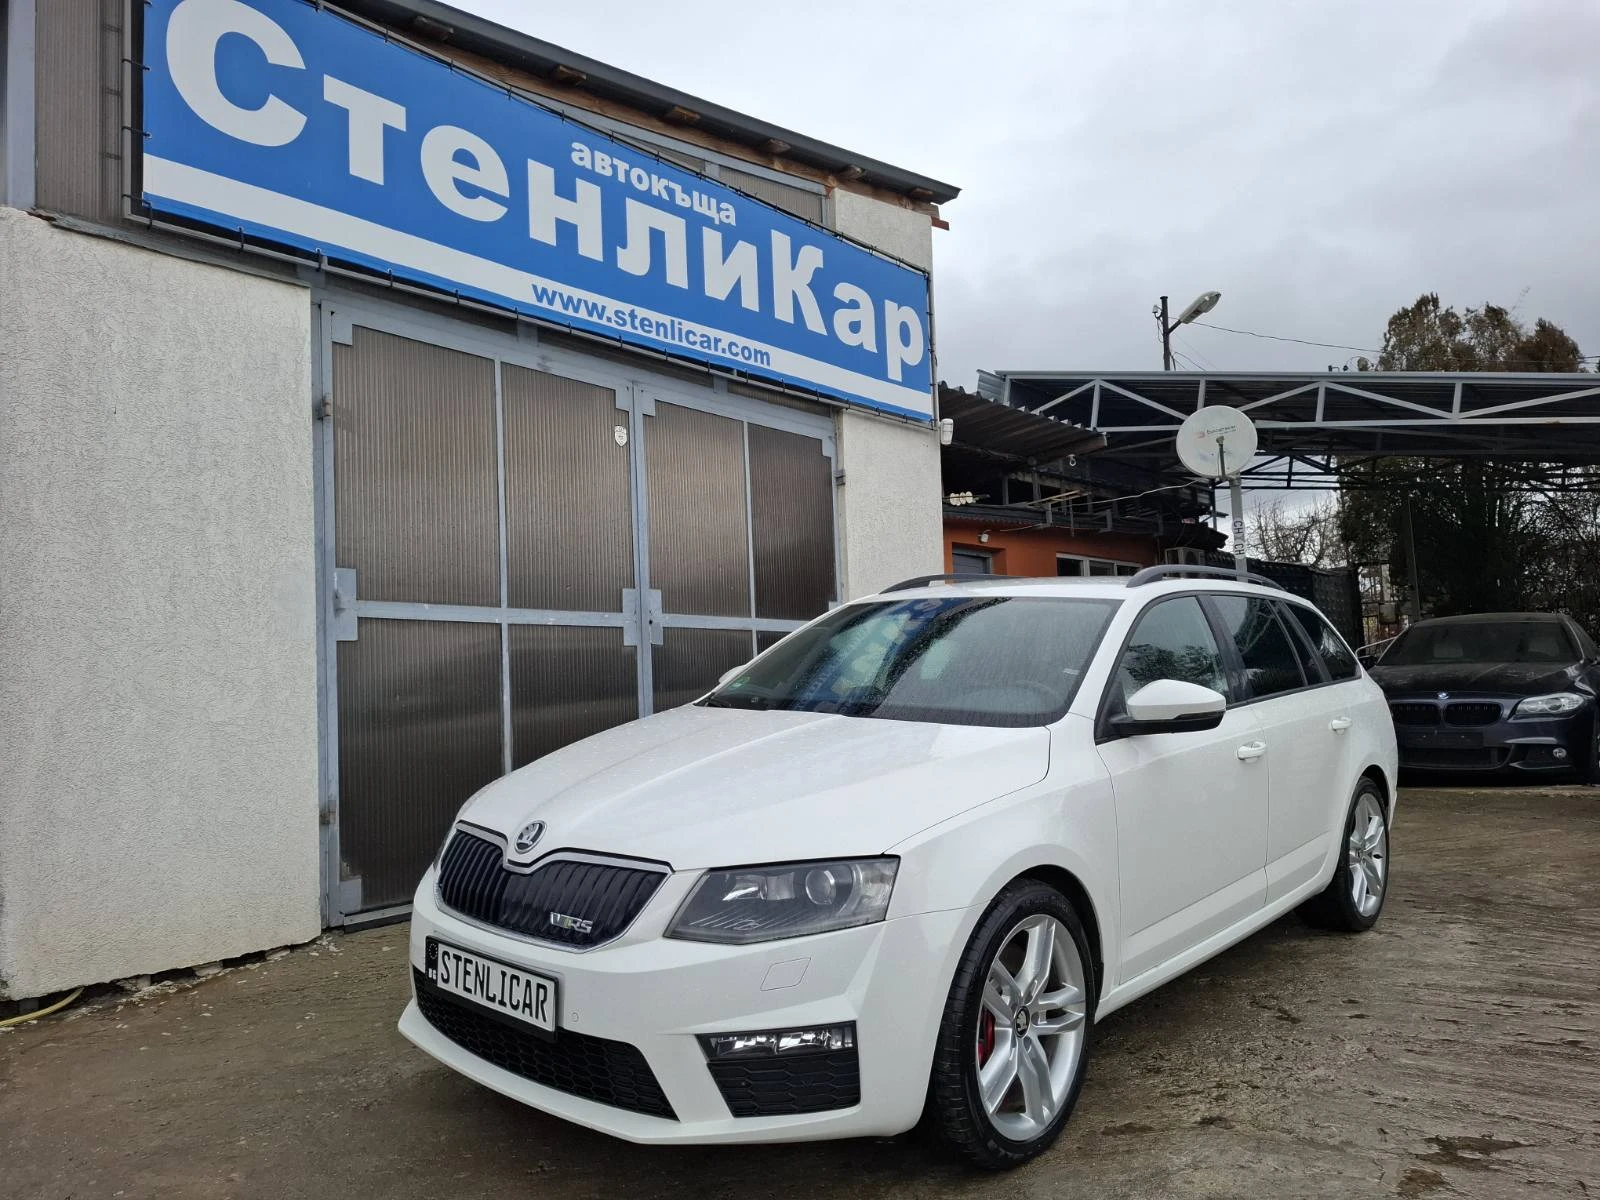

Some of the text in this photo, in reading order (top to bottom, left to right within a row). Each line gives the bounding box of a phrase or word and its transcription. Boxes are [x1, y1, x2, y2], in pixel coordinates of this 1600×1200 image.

[166, 0, 924, 382] СтенлиКар
[570, 141, 736, 227] автокъща
[531, 283, 771, 369] www.stenlicar.com
[440, 950, 548, 1023] STENLICAR
